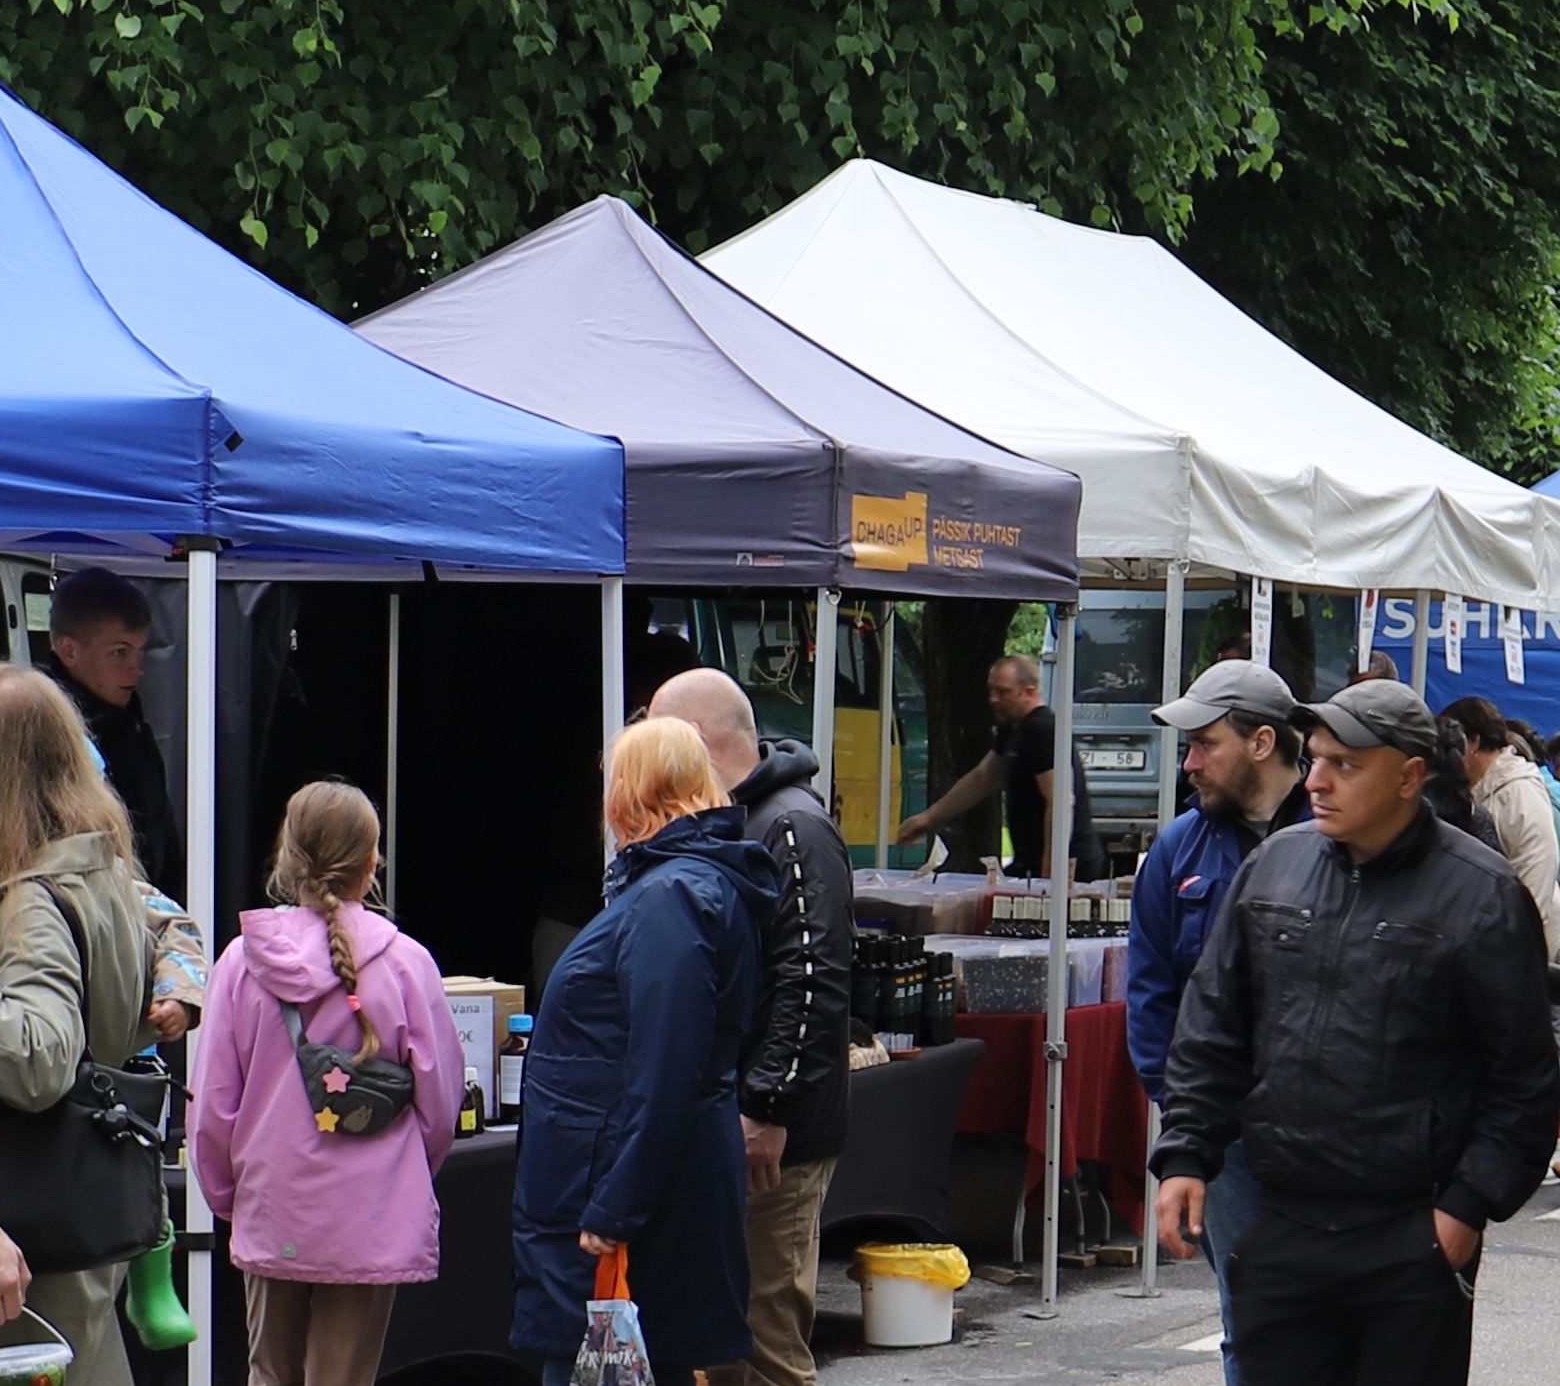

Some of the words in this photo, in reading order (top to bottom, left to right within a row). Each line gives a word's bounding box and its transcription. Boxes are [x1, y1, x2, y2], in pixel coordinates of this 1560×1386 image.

[973, 522, 1021, 547] PUHTAST
[933, 545, 984, 569] METSAST
[451, 1003, 481, 1014] Vana
